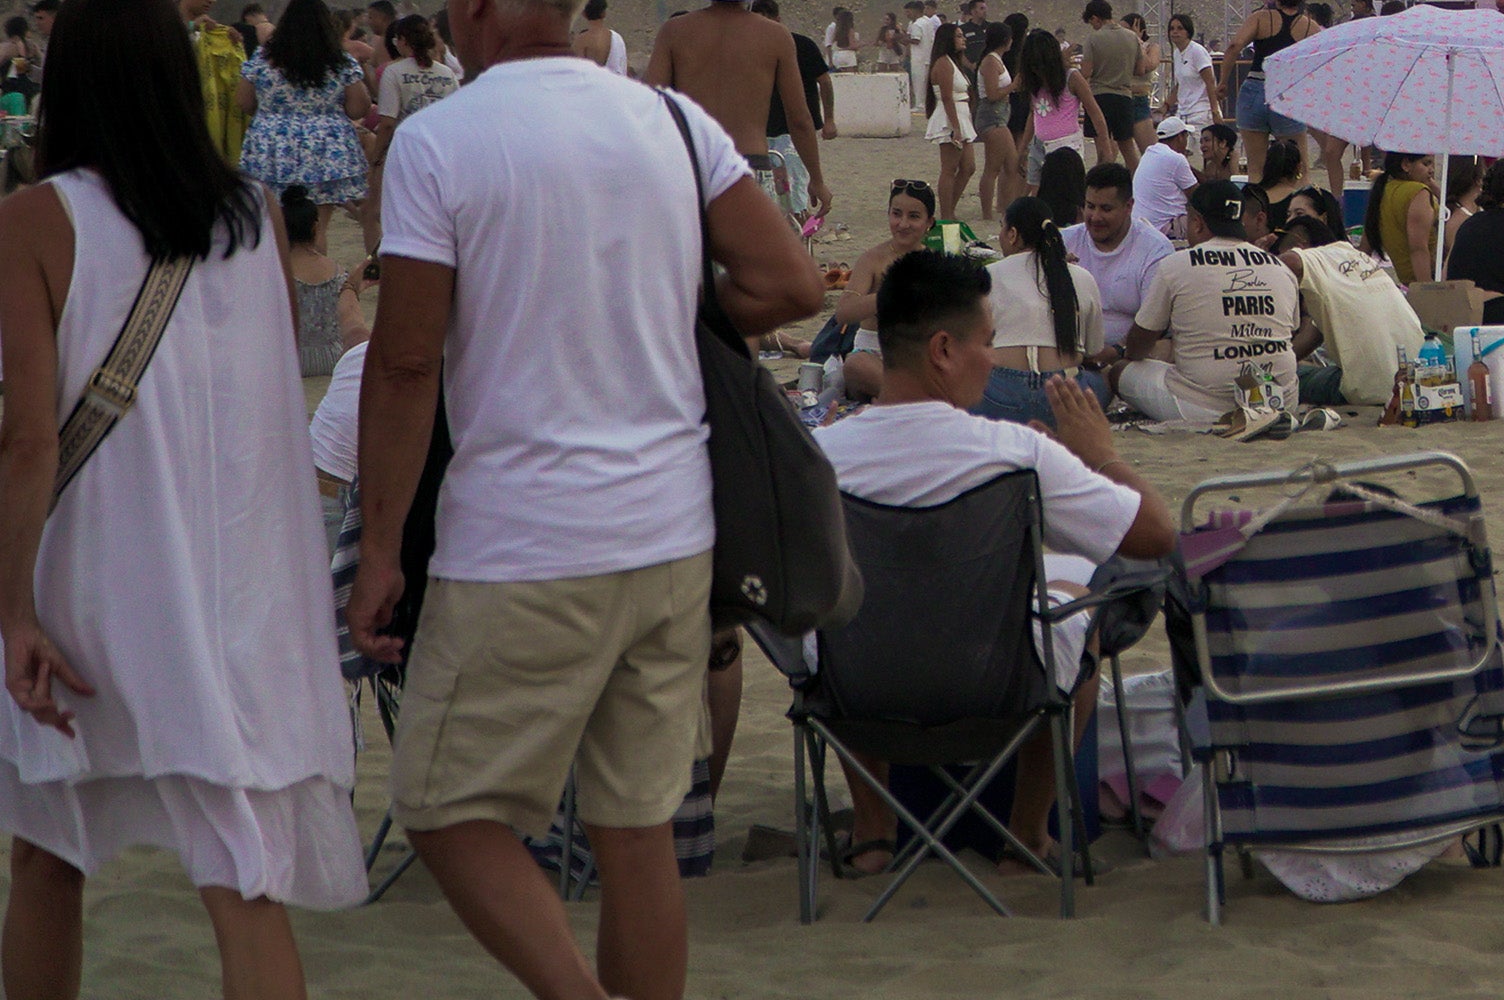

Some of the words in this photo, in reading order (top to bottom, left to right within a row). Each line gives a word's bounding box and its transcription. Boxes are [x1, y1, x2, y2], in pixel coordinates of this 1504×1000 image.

[1189, 247, 1237, 267] New
[1222, 295, 1275, 317] PARIS
[1230, 323, 1273, 338] Milan
[1213, 340, 1289, 360] LONDON
